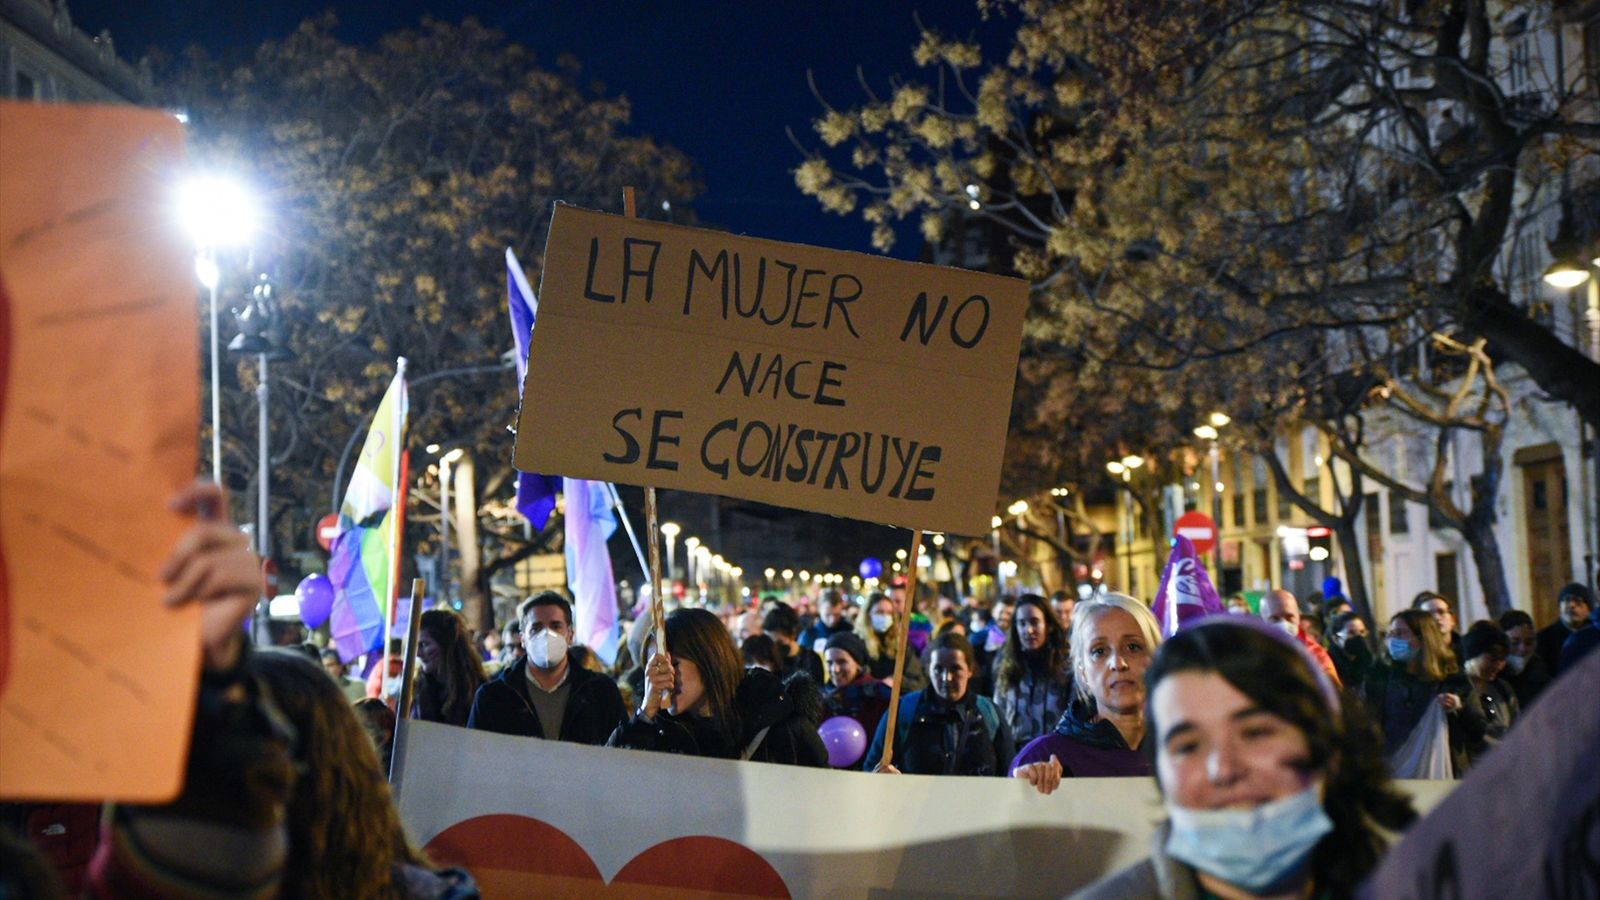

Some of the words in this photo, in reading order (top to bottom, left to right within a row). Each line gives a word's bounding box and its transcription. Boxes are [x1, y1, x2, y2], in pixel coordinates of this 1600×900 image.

[583, 236, 662, 304] LA
[682, 248, 864, 339] MUJER
[900, 291, 991, 349] NO
[714, 351, 847, 407] NACE
[603, 408, 683, 472] SE
[700, 417, 942, 501] CONSTRUYE
